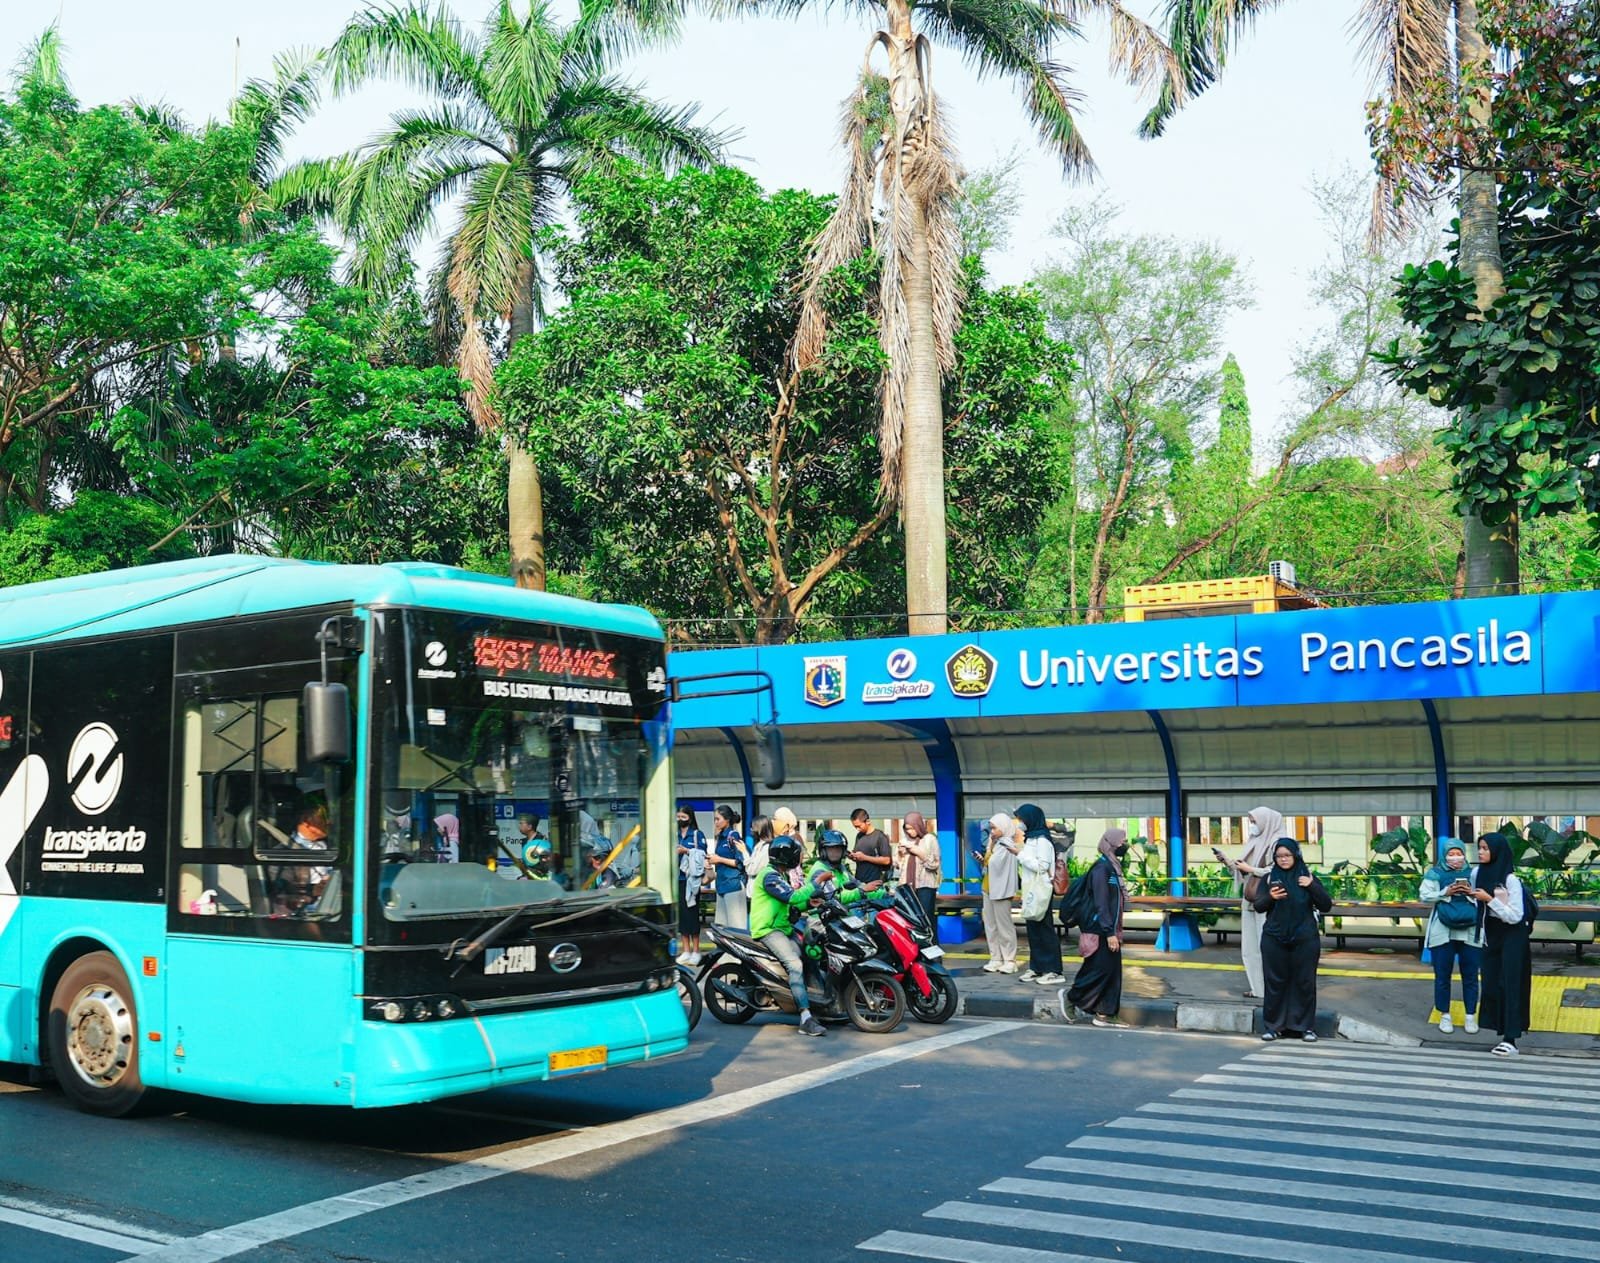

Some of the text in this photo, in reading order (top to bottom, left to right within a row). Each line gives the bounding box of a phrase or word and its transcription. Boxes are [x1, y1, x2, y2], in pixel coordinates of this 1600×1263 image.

[1020, 619, 1532, 688] Universitas Pancasila
[484, 681, 510, 697] BUS
[865, 682, 930, 699] transjakarta
[42, 826, 147, 859] transjakarta
